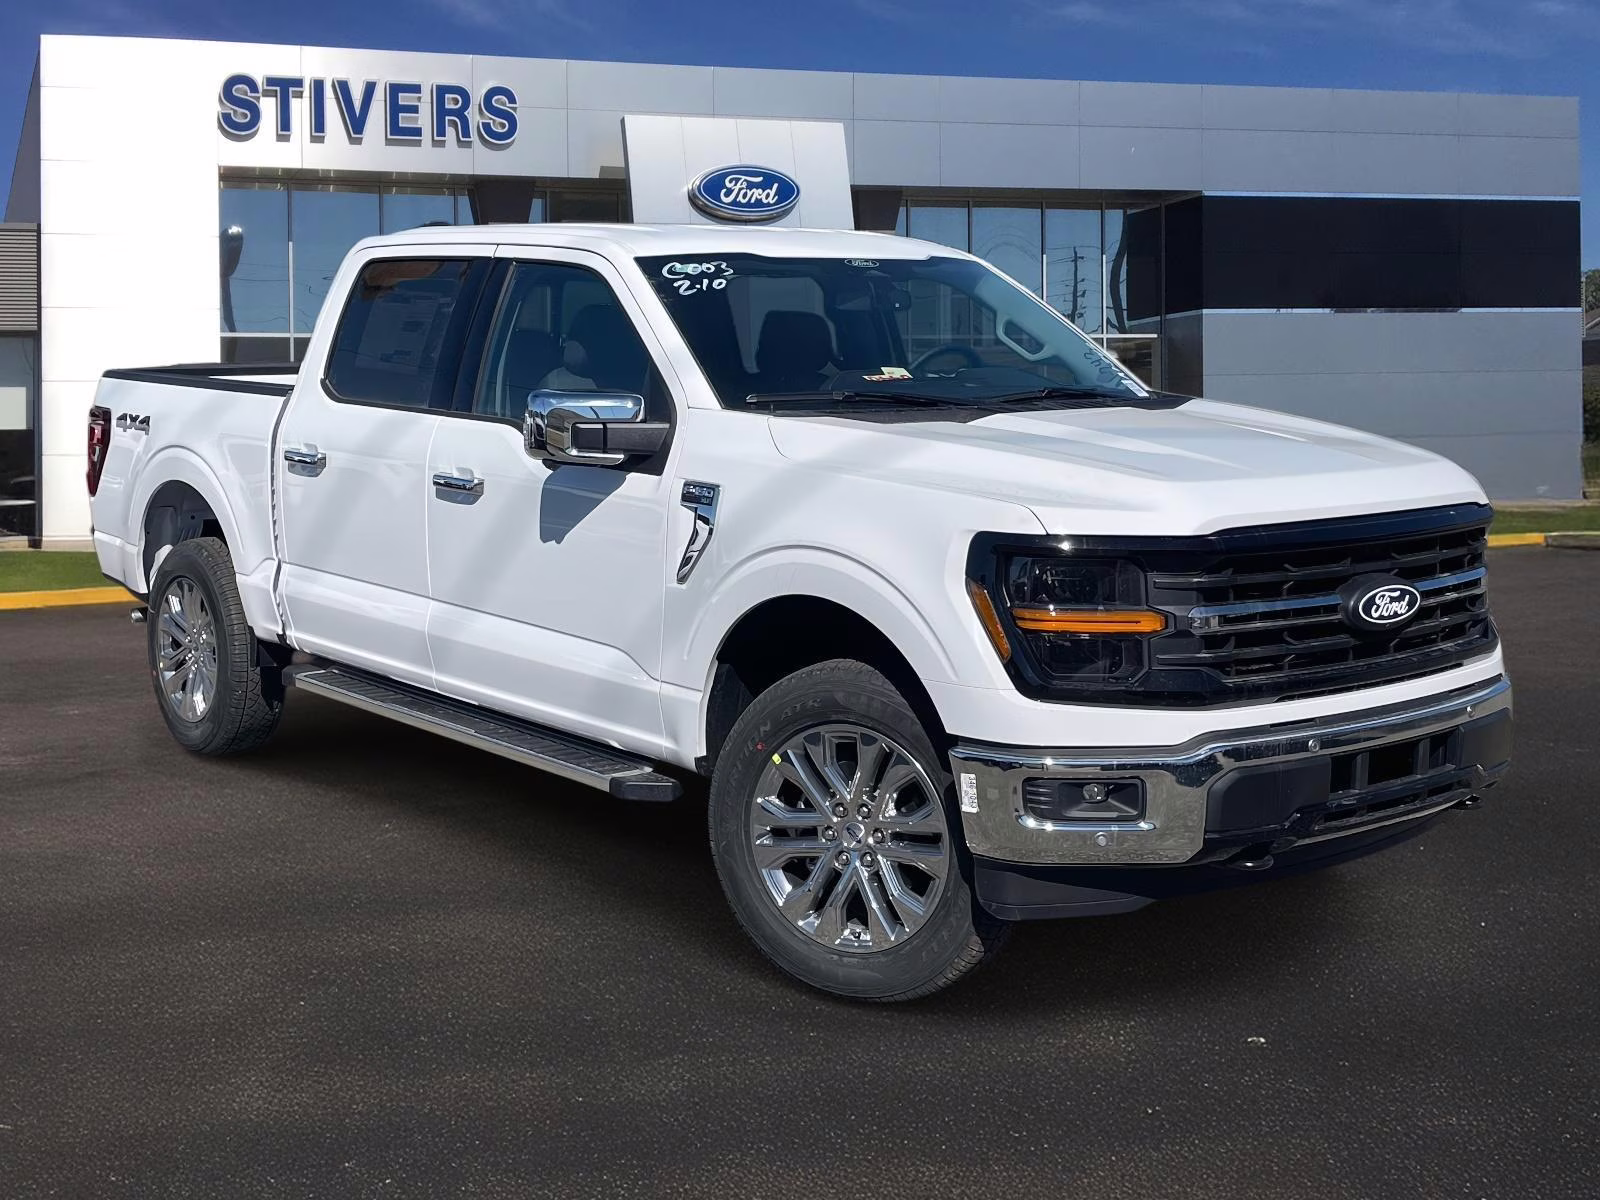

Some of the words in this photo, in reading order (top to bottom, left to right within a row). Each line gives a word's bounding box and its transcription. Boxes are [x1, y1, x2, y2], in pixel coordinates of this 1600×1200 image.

[218, 73, 518, 147] STIVERS
[720, 174, 779, 204] Ford
[1371, 590, 1410, 618] Ford
